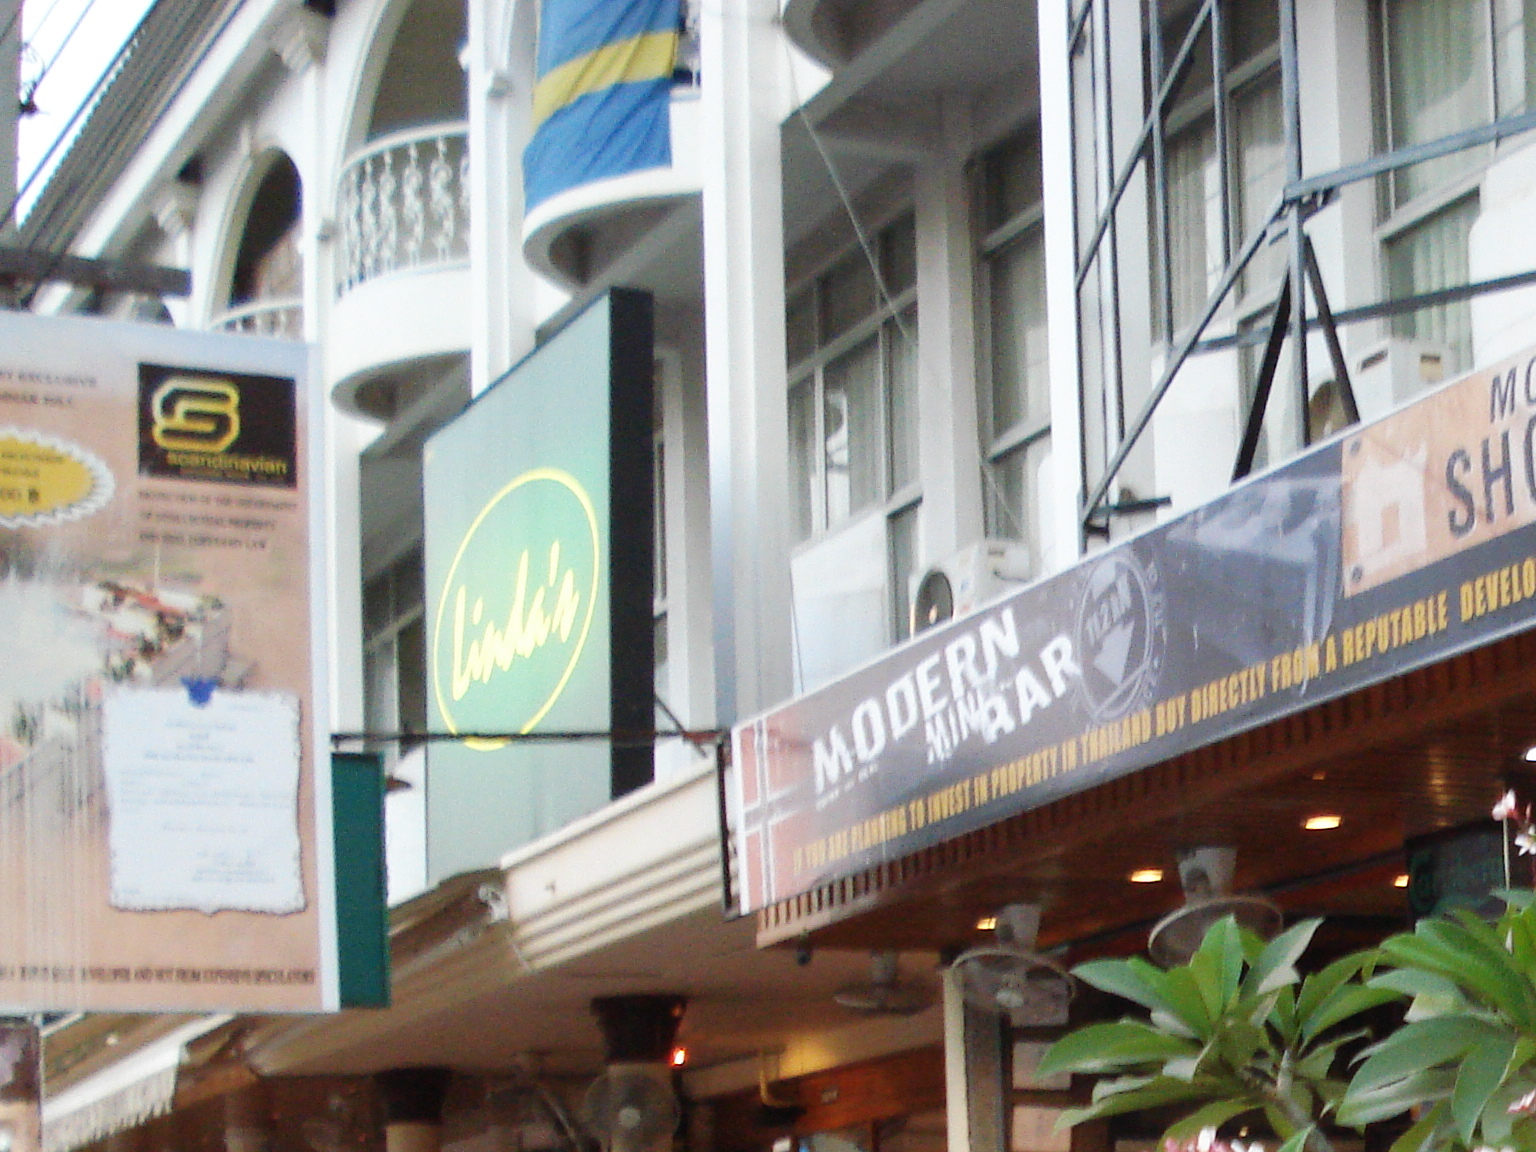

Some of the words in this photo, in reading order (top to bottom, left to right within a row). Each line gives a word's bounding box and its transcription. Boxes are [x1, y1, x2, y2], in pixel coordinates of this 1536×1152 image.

[812, 606, 1020, 796] MODERN
[909, 798, 926, 831] TO
[927, 779, 971, 824] INVEST
[974, 773, 989, 806] IN
[991, 746, 1058, 799] PROPERTY
[1062, 737, 1078, 773] IN
[1155, 694, 1187, 738] BUY
[1190, 662, 1266, 724] DIRECTLY
[1271, 642, 1320, 693] FROM
[1325, 634, 1338, 673] A
[1342, 589, 1449, 666] REPUTABLE
